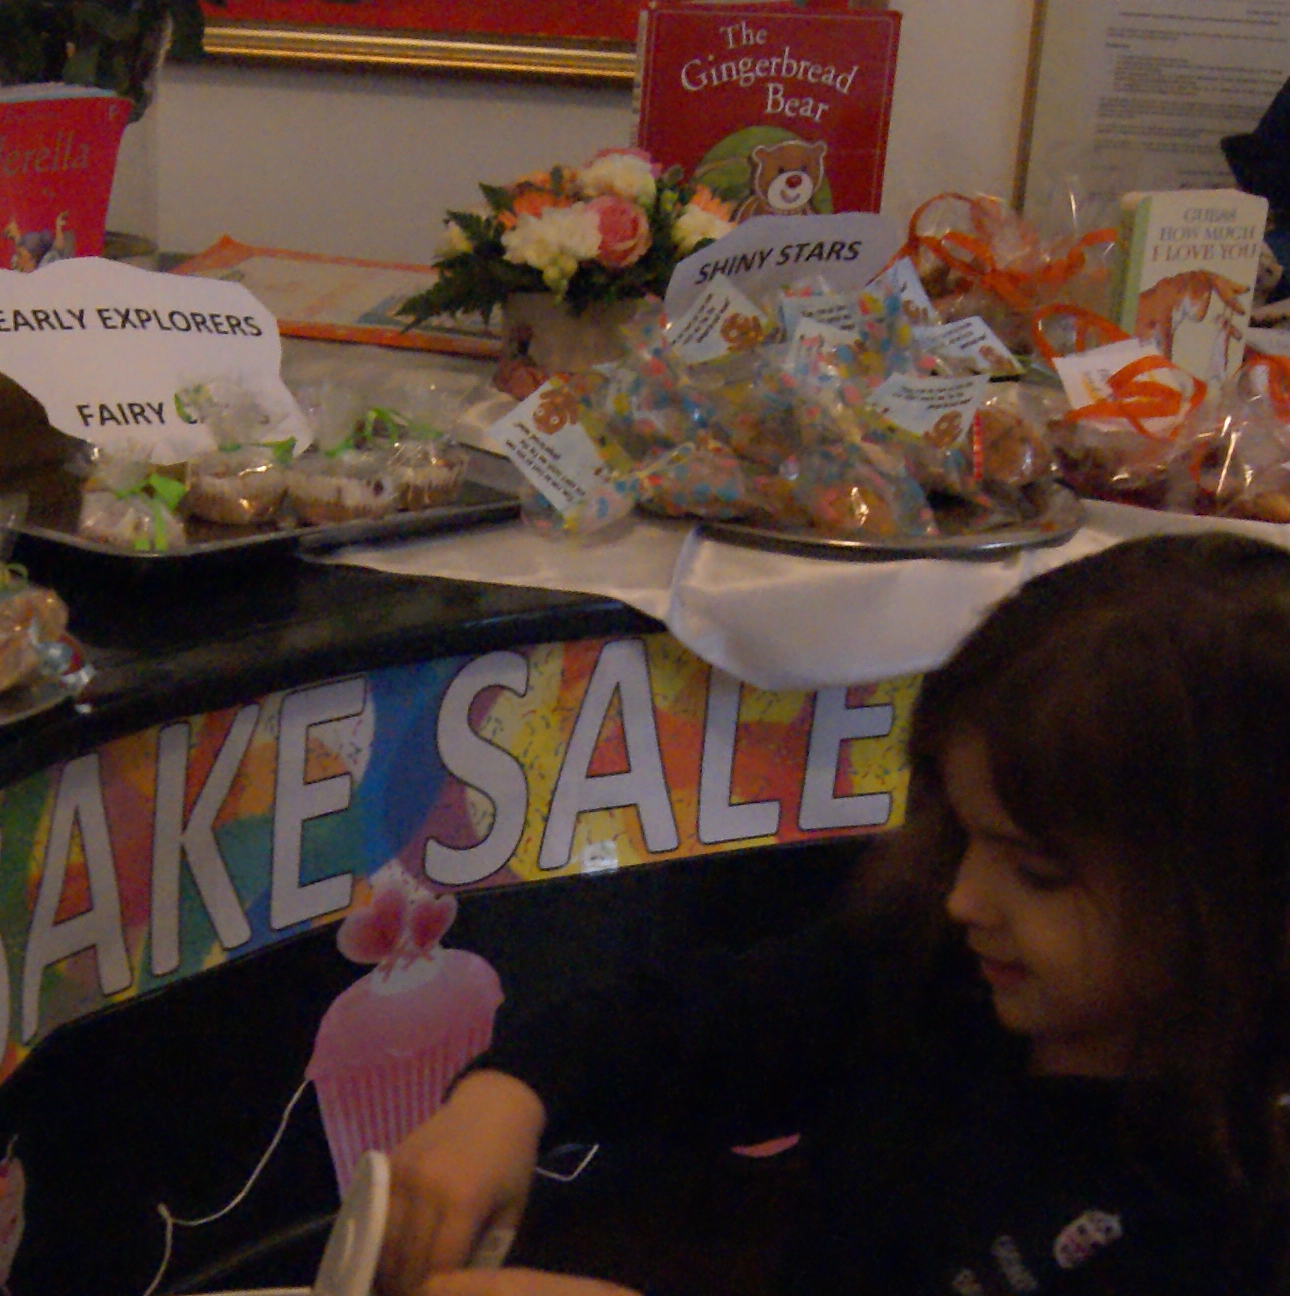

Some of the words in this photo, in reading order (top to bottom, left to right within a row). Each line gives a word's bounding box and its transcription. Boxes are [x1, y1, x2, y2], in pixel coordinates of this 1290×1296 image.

[719, 20, 769, 50] The
[680, 45, 860, 95] Gingerbread
[763, 82, 830, 123] Bear
[1159, 226, 1199, 241] HOW
[1204, 225, 1256, 241] MUCH
[695, 247, 774, 285] SHINY
[776, 241, 862, 266] STARS
[1165, 244, 1214, 261] LOVE
[1219, 243, 1257, 260] YOU
[96, 307, 263, 337] EXPLORERS
[76, 402, 166, 427] FAIRY
[422, 636, 895, 889] SALE
